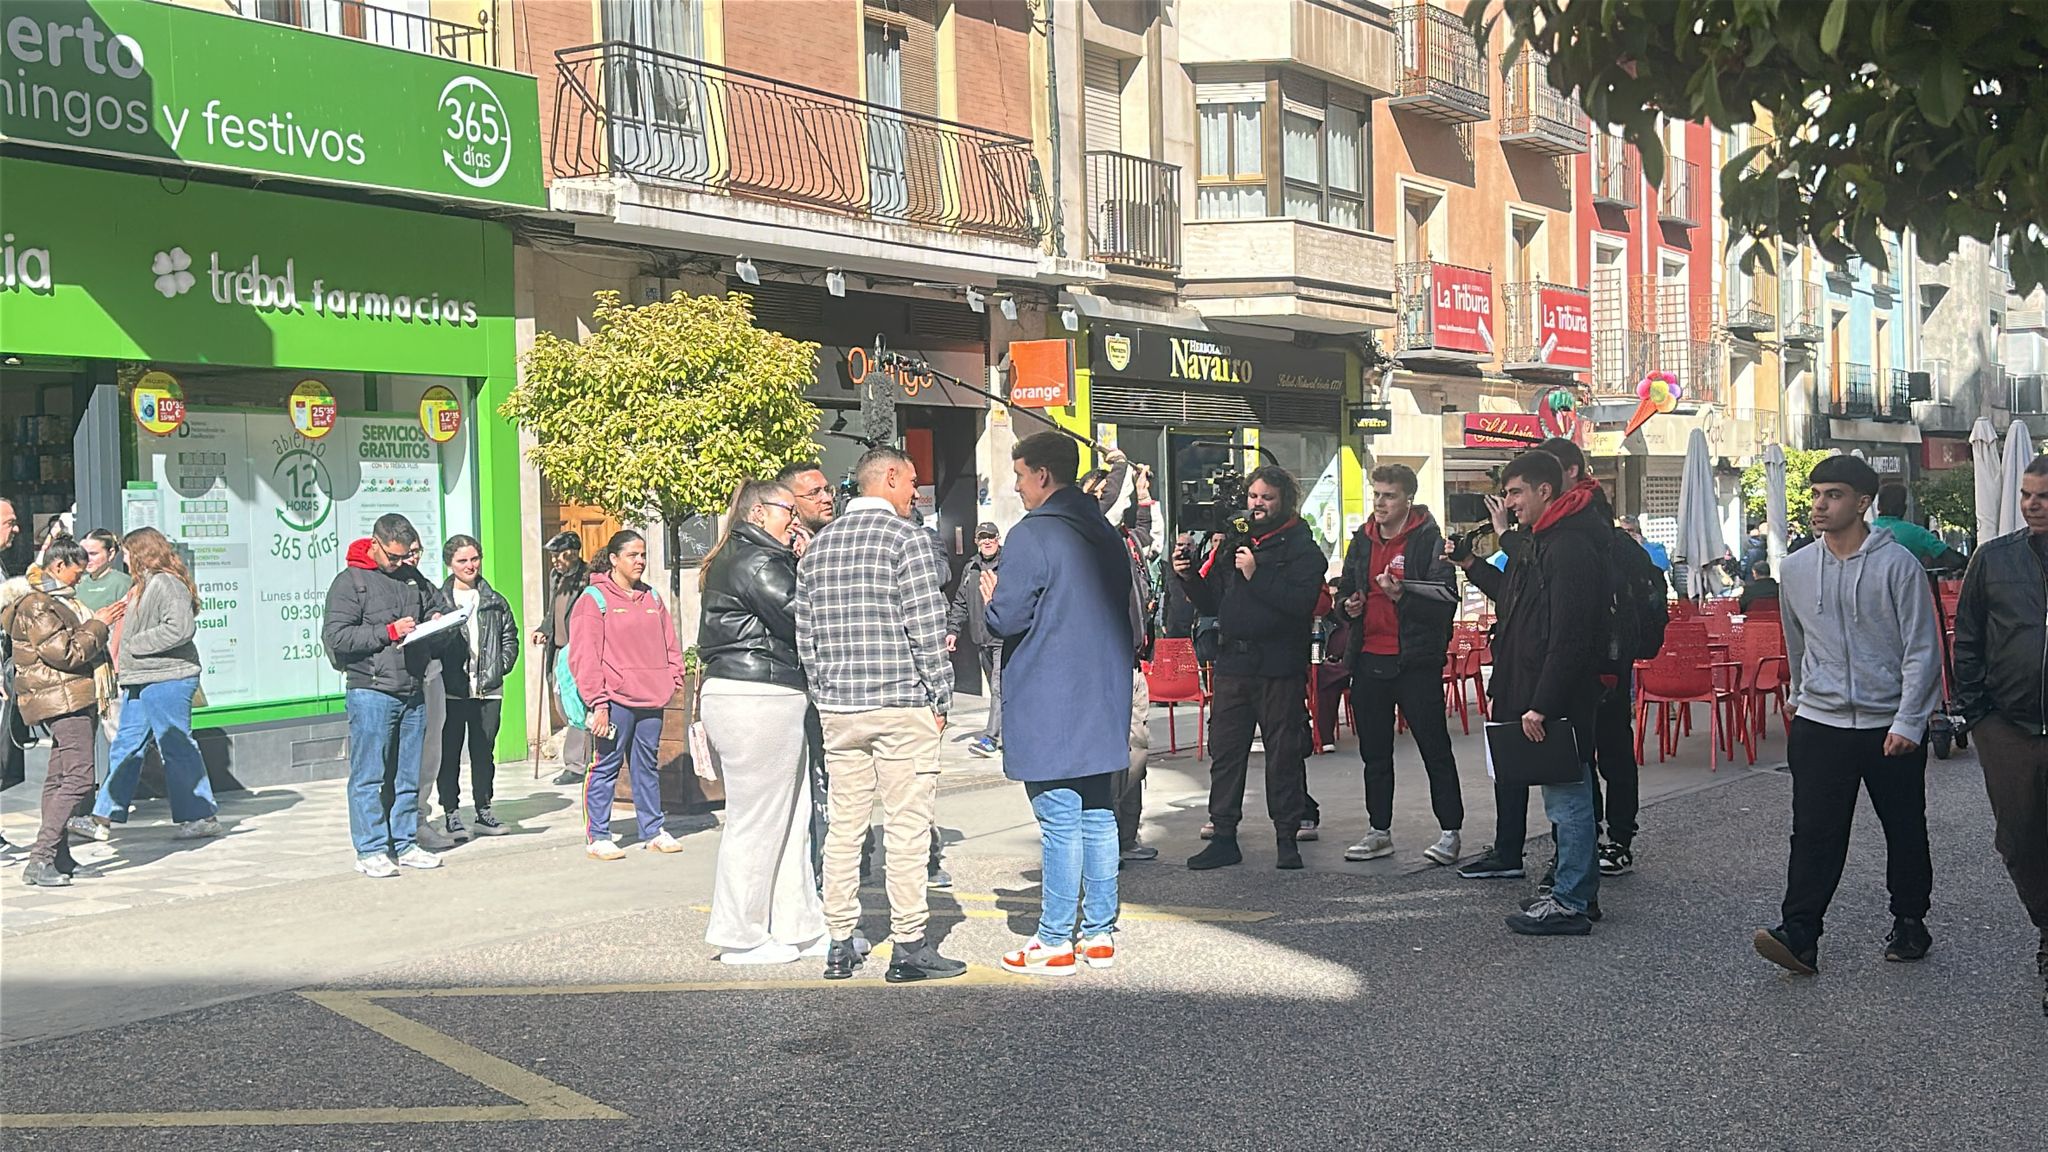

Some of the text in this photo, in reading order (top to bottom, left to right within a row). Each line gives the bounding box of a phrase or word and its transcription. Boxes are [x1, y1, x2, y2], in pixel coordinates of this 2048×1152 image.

[0, 16, 144, 79] erto
[162, 105, 189, 150] y
[202, 100, 366, 166] festivos
[446, 97, 498, 145] 365
[462, 145, 492, 169] días
[0, 233, 51, 289] ia
[207, 251, 478, 324] trébol farmacias
[1437, 281, 1490, 315] La Tribuna
[1543, 304, 1588, 333] La Tribuna
[1170, 338, 1253, 384] Navarro
[1013, 385, 1061, 402] orange
[312, 407, 335, 417] 25'35
[272, 431, 326, 457] abierto
[362, 424, 426, 443] SERVICIOS
[359, 441, 430, 459] GRATUITOS
[286, 463, 317, 498] 12
[286, 500, 319, 511] HORAS
[271, 532, 339, 560] 365 días
[199, 581, 239, 593] ramos
[260, 591, 292, 602] Lunes
[294, 592, 301, 600] a
[200, 597, 237, 611] tillero
[195, 615, 228, 630] nsual
[302, 628, 310, 640] a
[282, 643, 326, 661] 21:30
